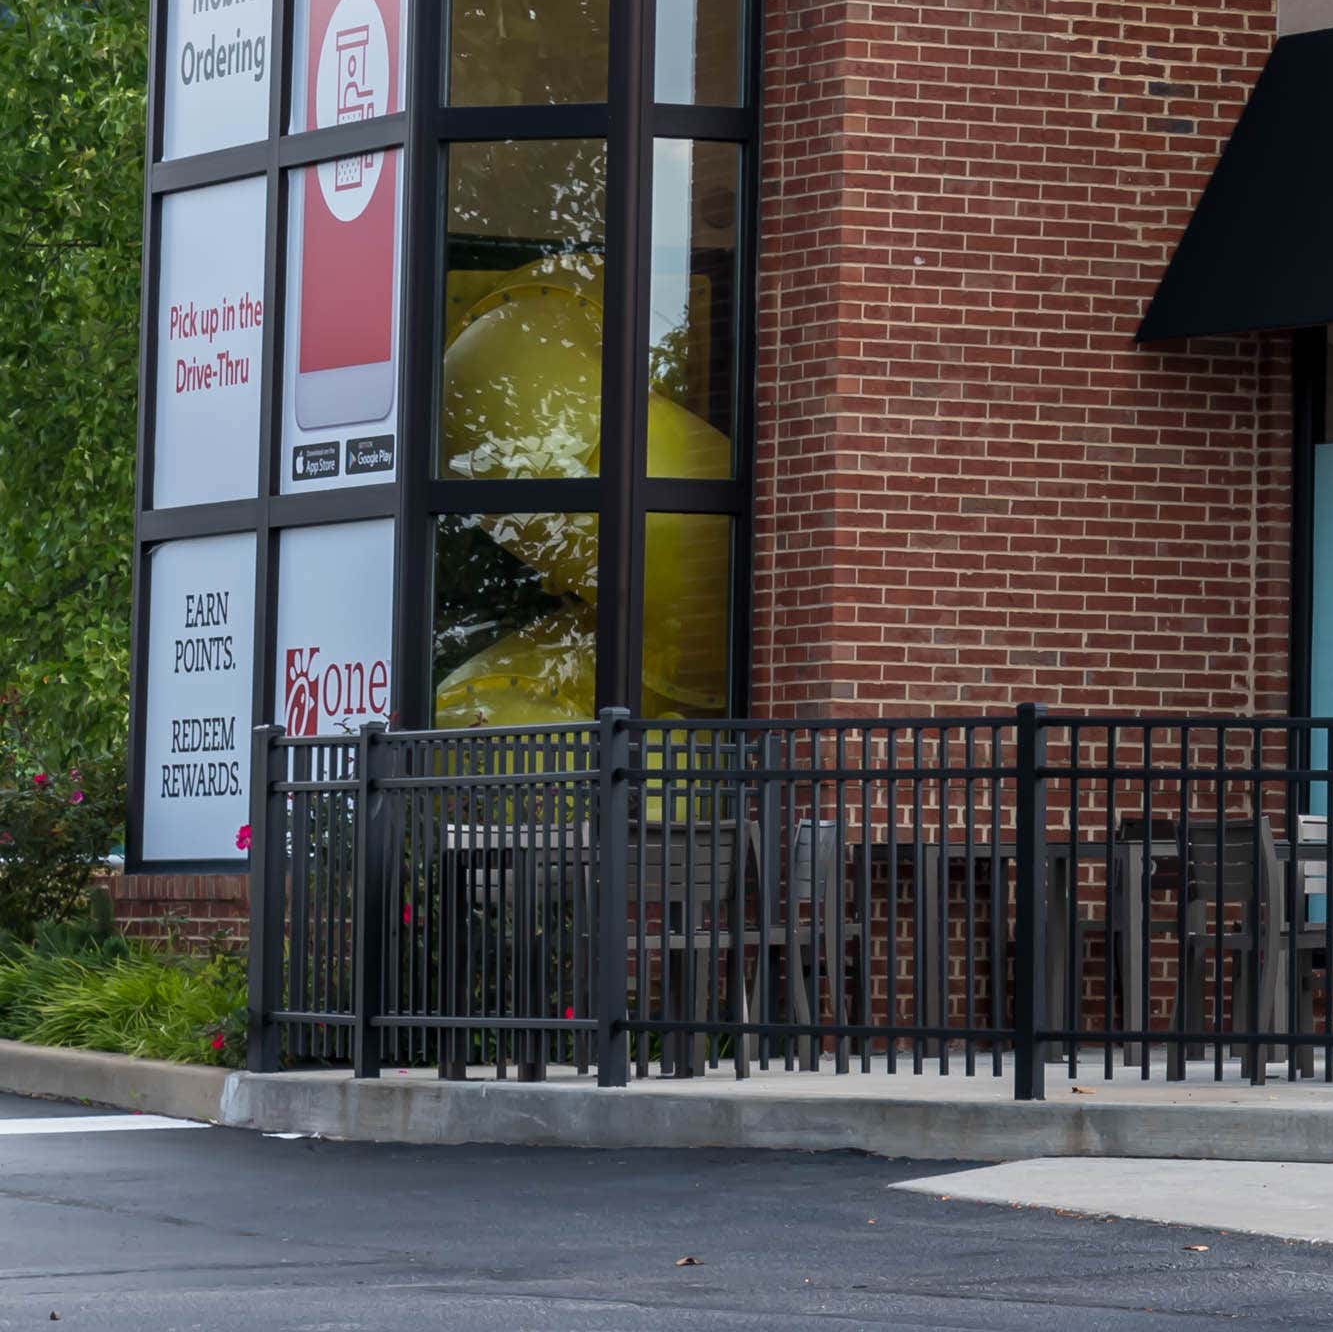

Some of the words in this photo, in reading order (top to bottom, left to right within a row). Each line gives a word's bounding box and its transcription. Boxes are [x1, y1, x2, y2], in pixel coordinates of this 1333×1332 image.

[181, 28, 266, 86] Ordering
[170, 301, 197, 340] Pick
[201, 307, 219, 343] up
[222, 297, 235, 331] in
[239, 292, 263, 328] the
[176, 350, 249, 393] Drive-Thru
[305, 459, 319, 475] App
[319, 458, 336, 472] Store
[357, 450, 379, 467] Google
[379, 449, 393, 465] Play
[185, 591, 229, 628] EARN
[174, 636, 236, 673] POINTS.
[322, 660, 388, 717] one
[171, 717, 236, 754] REDEEM
[161, 761, 243, 798] REWARDS.
